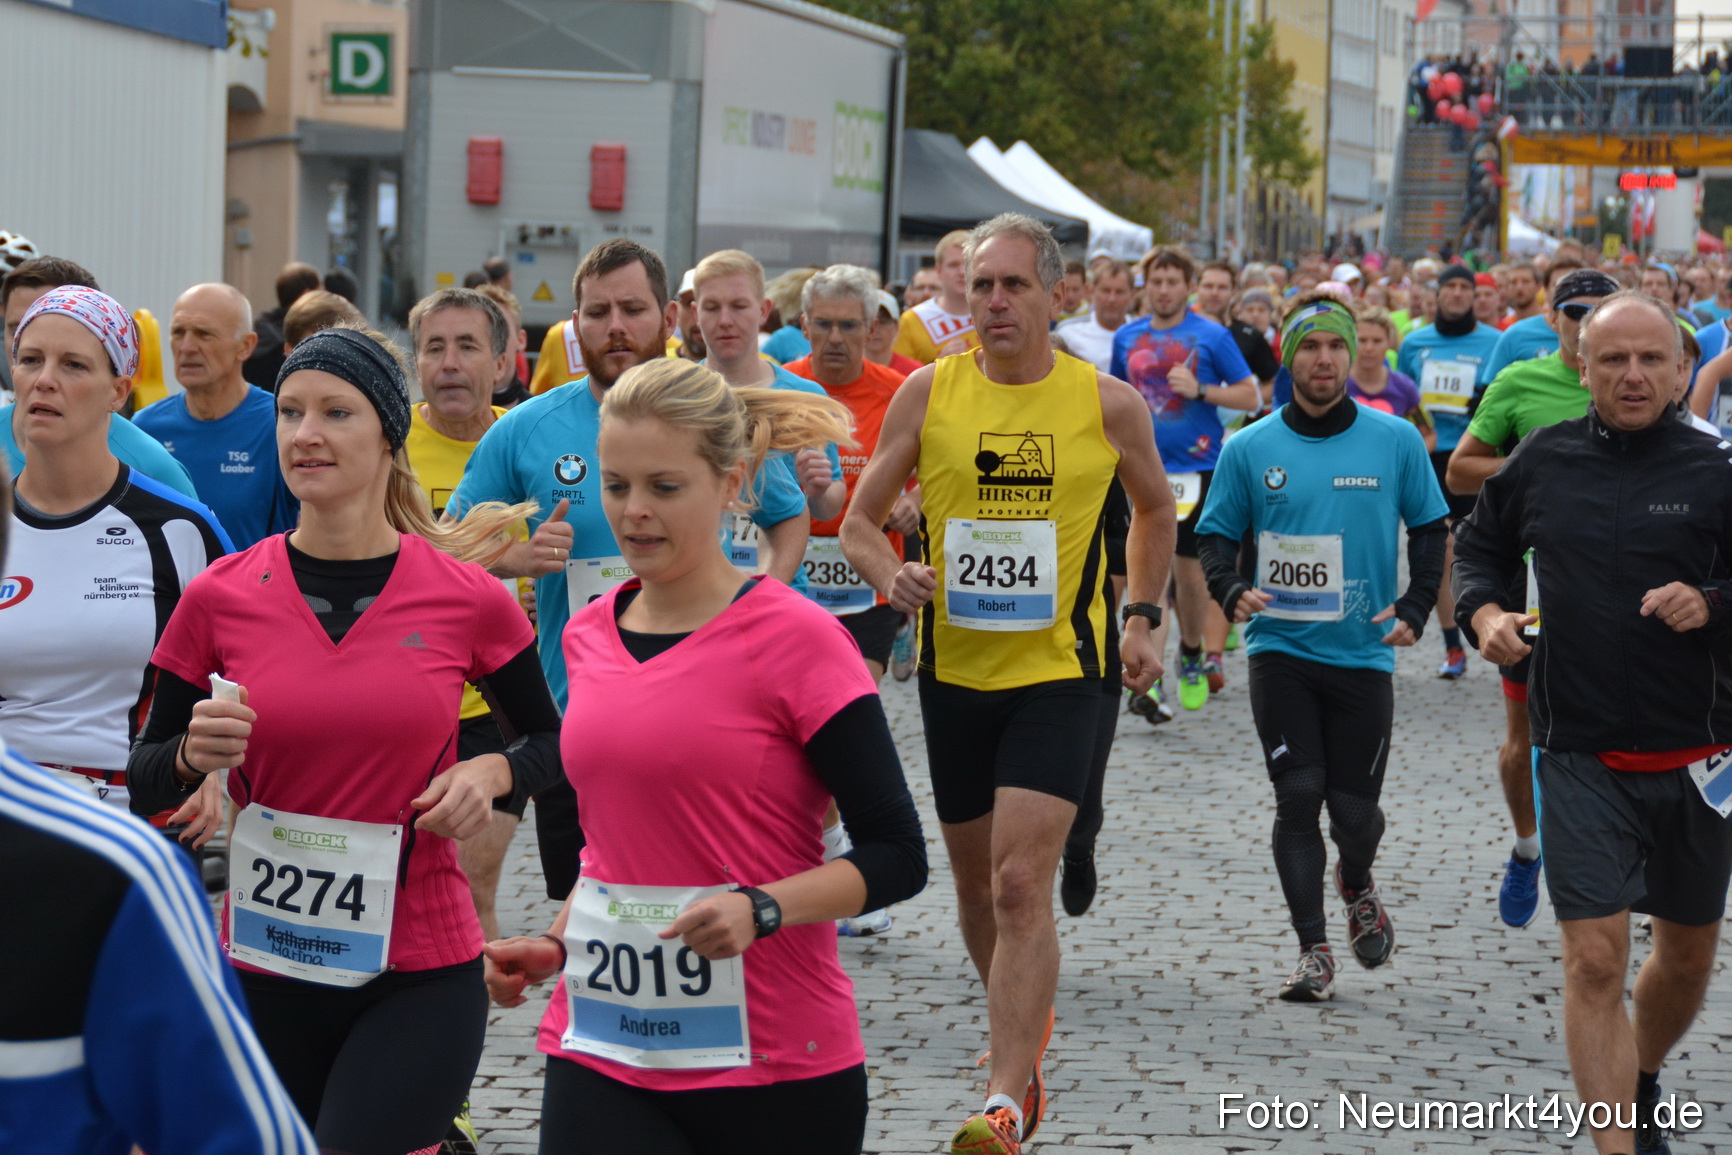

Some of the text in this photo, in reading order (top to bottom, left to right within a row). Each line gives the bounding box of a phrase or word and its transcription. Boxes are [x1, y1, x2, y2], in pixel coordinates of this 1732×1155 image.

[339, 41, 385, 89] D
[1434, 376, 1461, 392] 118
[228, 450, 249, 462] TSG
[220, 463, 256, 473] Laaber
[1332, 476, 1381, 488] BOCK
[551, 489, 586, 499] PARTL
[977, 487, 1053, 502] HIRSCH
[978, 508, 1050, 516] APOTHEKE
[1648, 503, 1690, 513] FALKE
[982, 530, 1022, 541] BOCK
[613, 566, 636, 577] BO
[958, 553, 1039, 588] 2434
[1268, 559, 1328, 588] 2066
[99, 583, 140, 592] klinikum
[84, 592, 127, 601] nürnberg
[816, 591, 849, 602] Michael
[1277, 594, 1320, 606] Alexander
[977, 598, 1017, 613] Robert
[287, 829, 348, 850] BOCK
[251, 858, 366, 922] 2274
[619, 903, 679, 920] BOCK
[271, 942, 326, 967] Marina
[586, 939, 712, 997] 2019
[619, 1014, 681, 1037] Andrea
